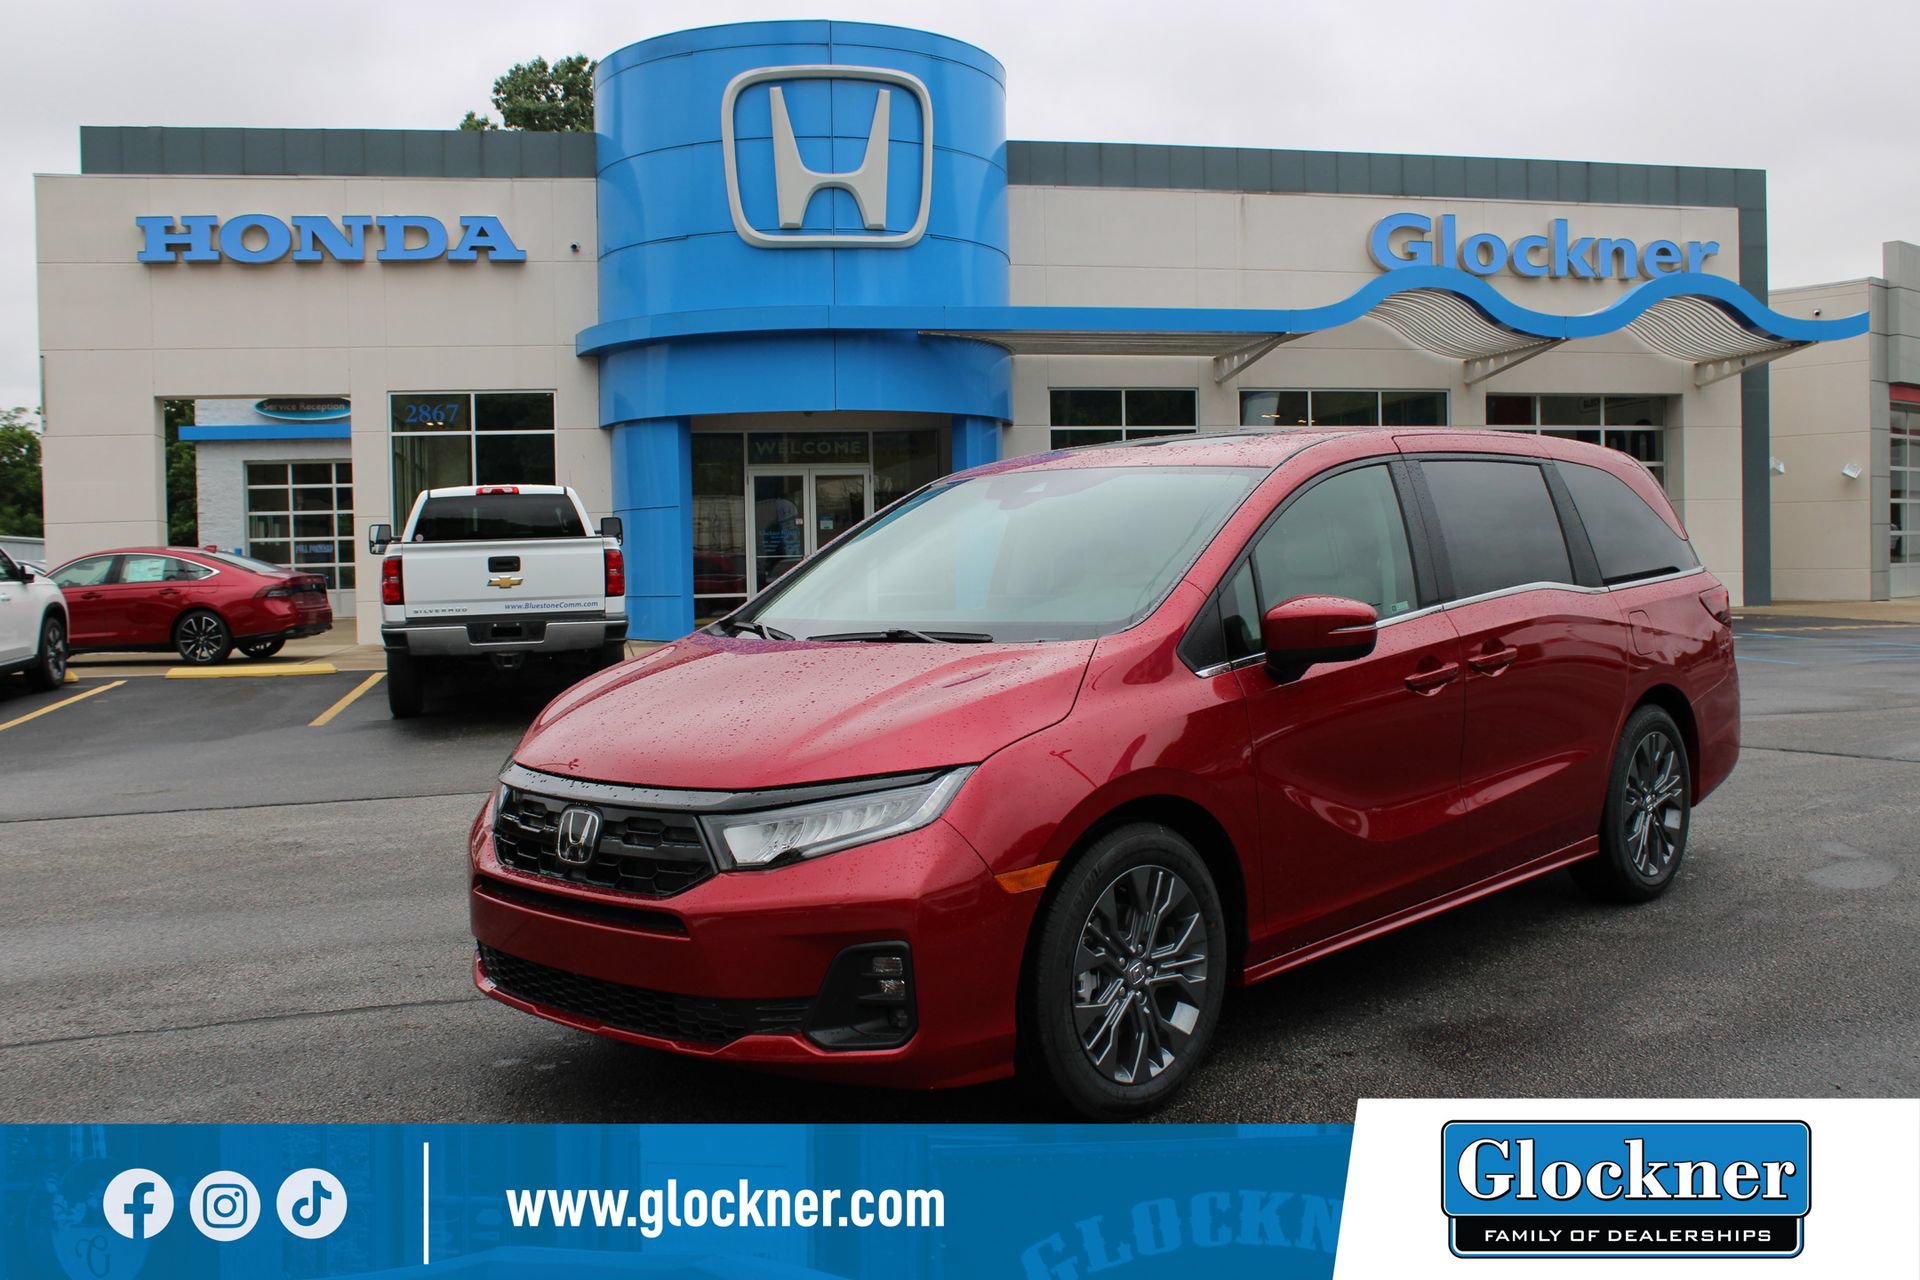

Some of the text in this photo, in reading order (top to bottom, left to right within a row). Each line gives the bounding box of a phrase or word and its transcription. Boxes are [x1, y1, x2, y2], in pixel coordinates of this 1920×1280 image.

[136, 213, 528, 263] HONDA
[1367, 212, 1721, 280] Glockner
[262, 401, 346, 413] Service Reception
[405, 403, 460, 423] 2867
[755, 440, 862, 455] WELCOME
[504, 600, 599, 611] www.BluestoneComm.com
